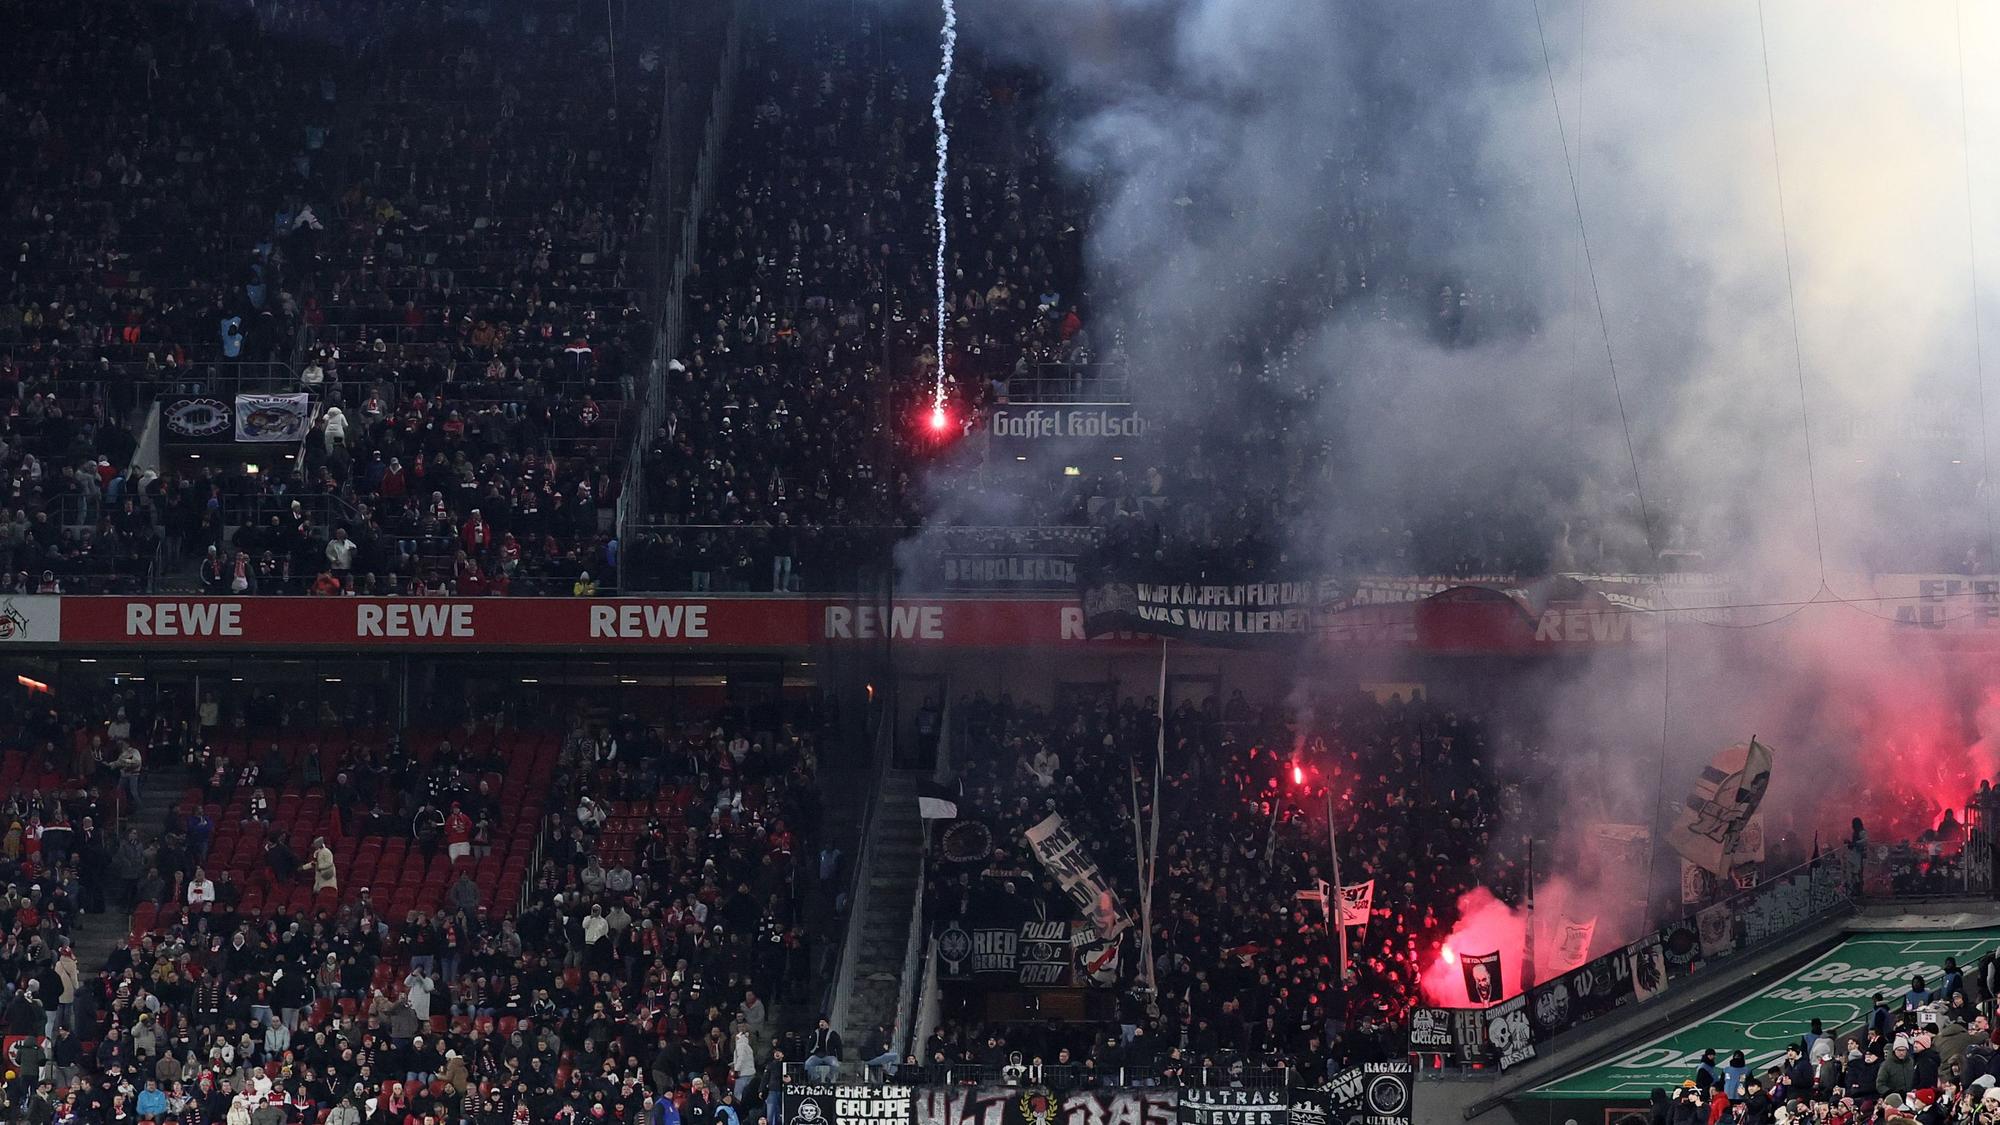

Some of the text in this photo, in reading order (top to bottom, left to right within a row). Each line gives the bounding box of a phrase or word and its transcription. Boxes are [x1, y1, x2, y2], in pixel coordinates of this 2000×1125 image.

[993, 410, 1064, 438] Gaffel
[126, 604, 242, 636] REWE
[357, 604, 474, 636] REWE
[589, 605, 708, 638] REWE
[825, 606, 944, 638] REWE
[1137, 605, 1185, 626] WAS
[1188, 609, 1231, 632] WIR
[1536, 609, 1656, 642] REWE
[1020, 921, 1065, 939] FULDA
[974, 932, 1017, 954] RIED
[974, 955, 1016, 970] GEBIET
[1019, 963, 1063, 985] CREW
[1364, 1062, 1412, 1073] RAGAZZI
[835, 1086, 872, 1099] EHRE
[1187, 1088, 1280, 1105] ULTRAS
[835, 1099, 911, 1118] GRUPPE
[1195, 1110, 1272, 1125] NEVER
[1367, 1116, 1409, 1125] ULTRAS
